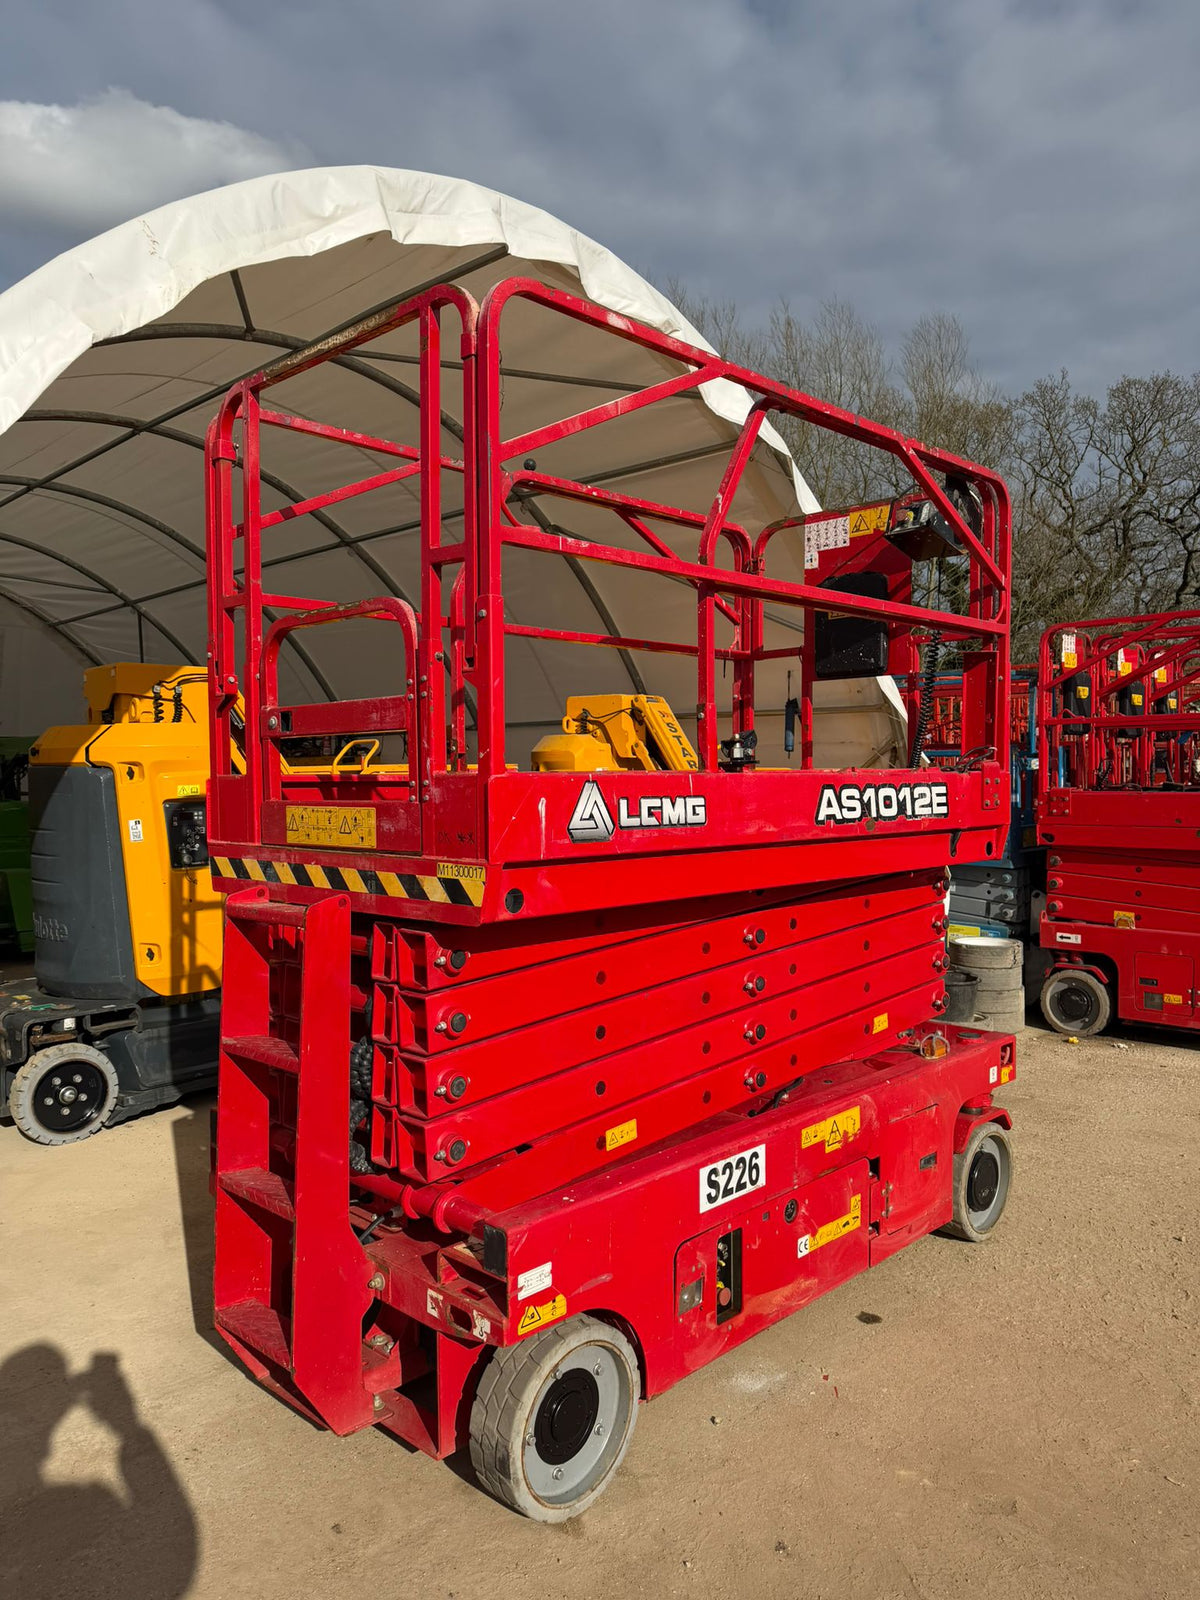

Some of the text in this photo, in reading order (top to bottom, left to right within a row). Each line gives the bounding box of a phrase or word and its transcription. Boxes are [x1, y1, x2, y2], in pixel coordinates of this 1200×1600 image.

[666, 722, 698, 769] STAR
[816, 784, 949, 823] AS1012E
[437, 863, 484, 879] M11300017
[33, 912, 69, 941] ulotte
[706, 1151, 760, 1204] S226
[798, 1238, 809, 1253] CE
